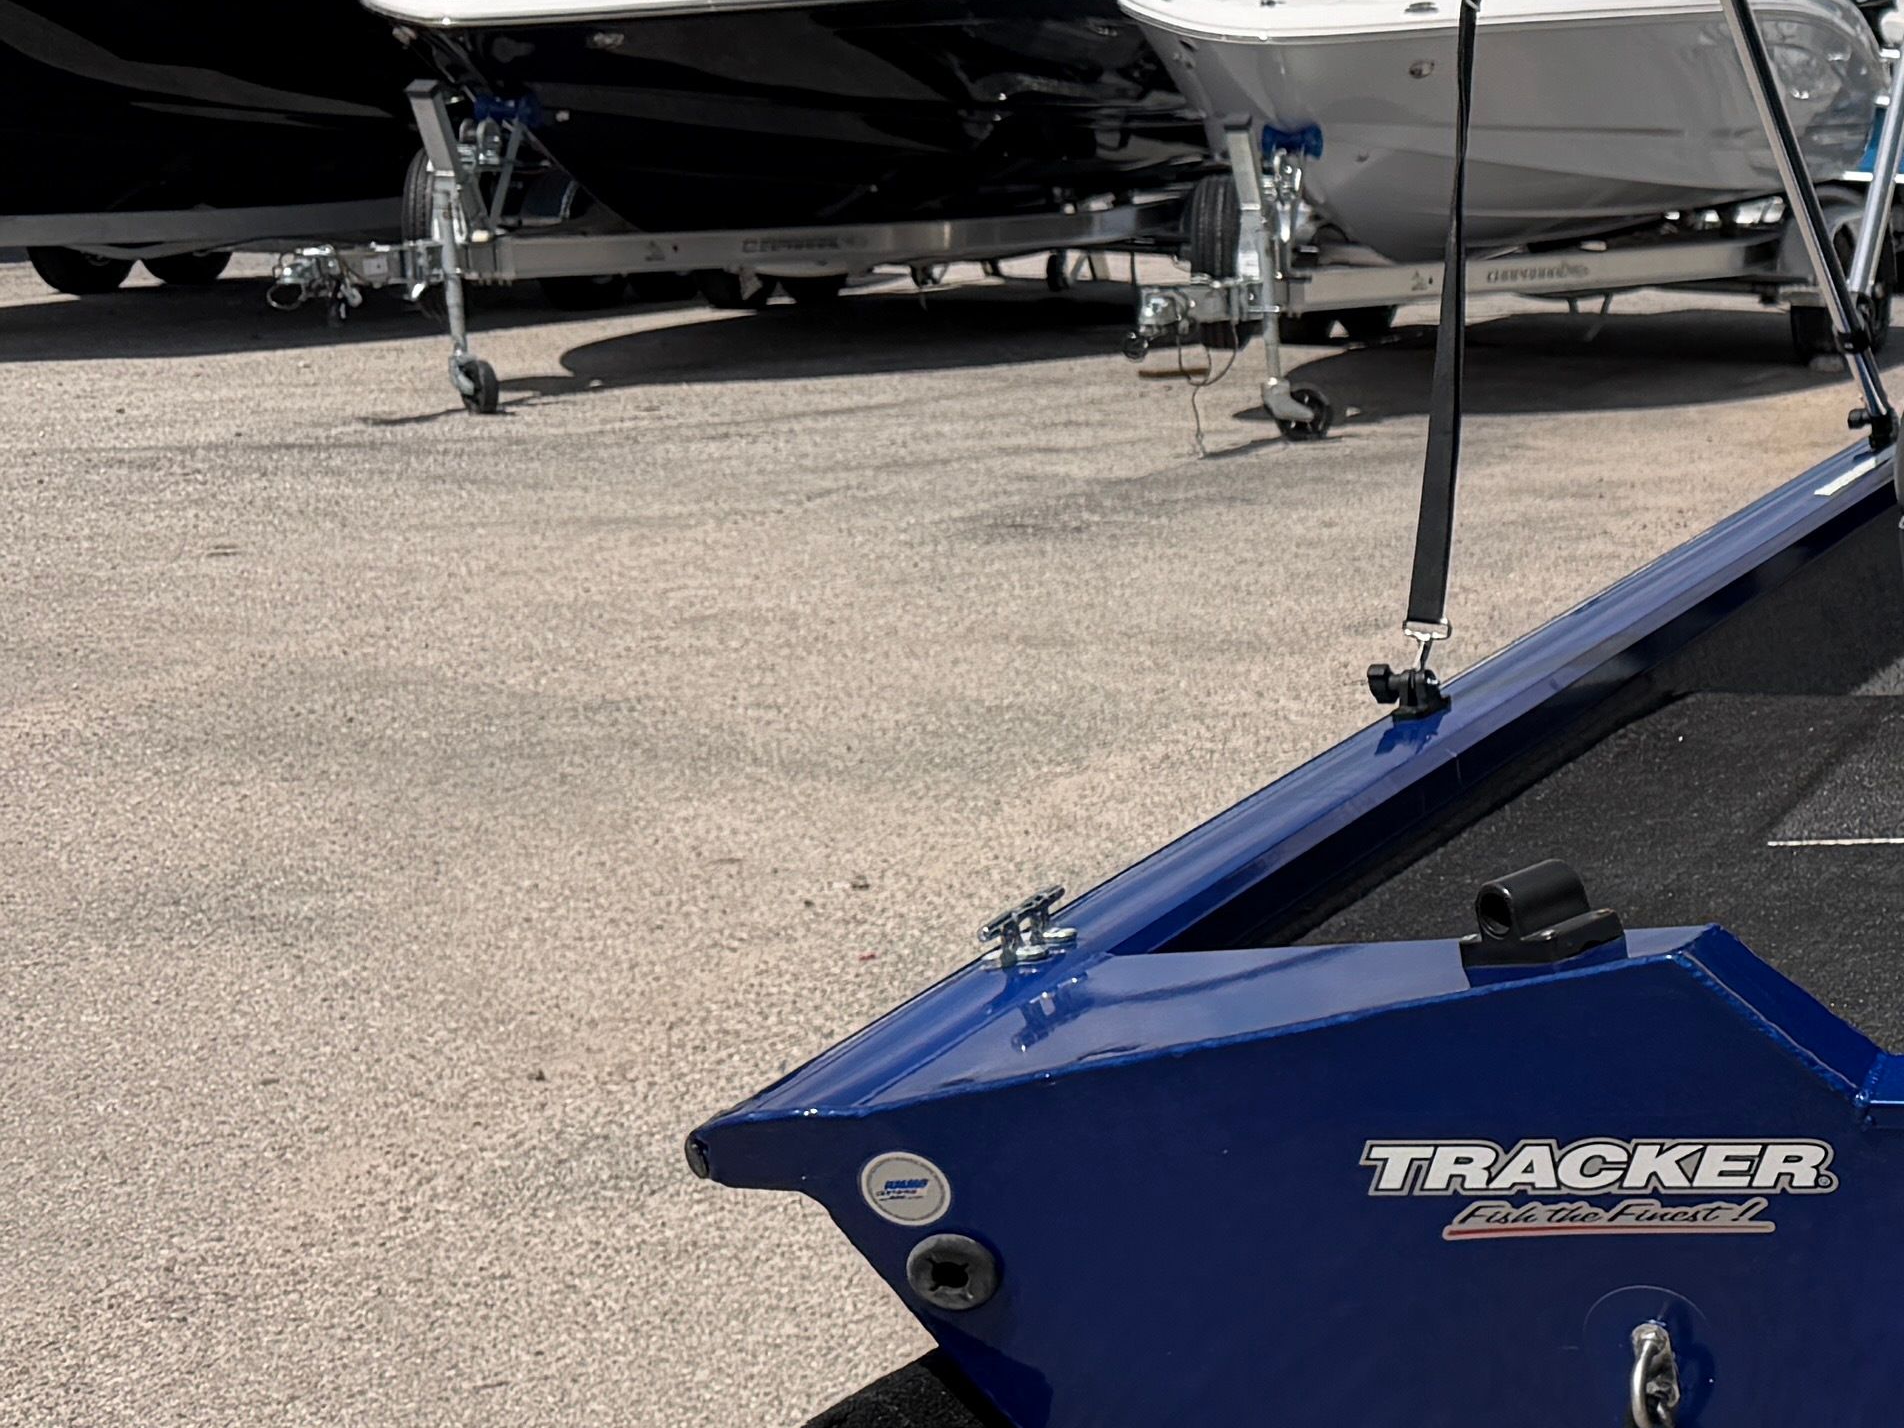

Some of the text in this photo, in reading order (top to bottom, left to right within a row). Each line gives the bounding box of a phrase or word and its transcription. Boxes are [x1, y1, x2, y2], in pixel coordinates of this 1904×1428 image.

[1364, 1142, 1830, 1191] TRACKER
[1459, 1203, 1537, 1224] Fish
[1546, 1203, 1602, 1223] the
